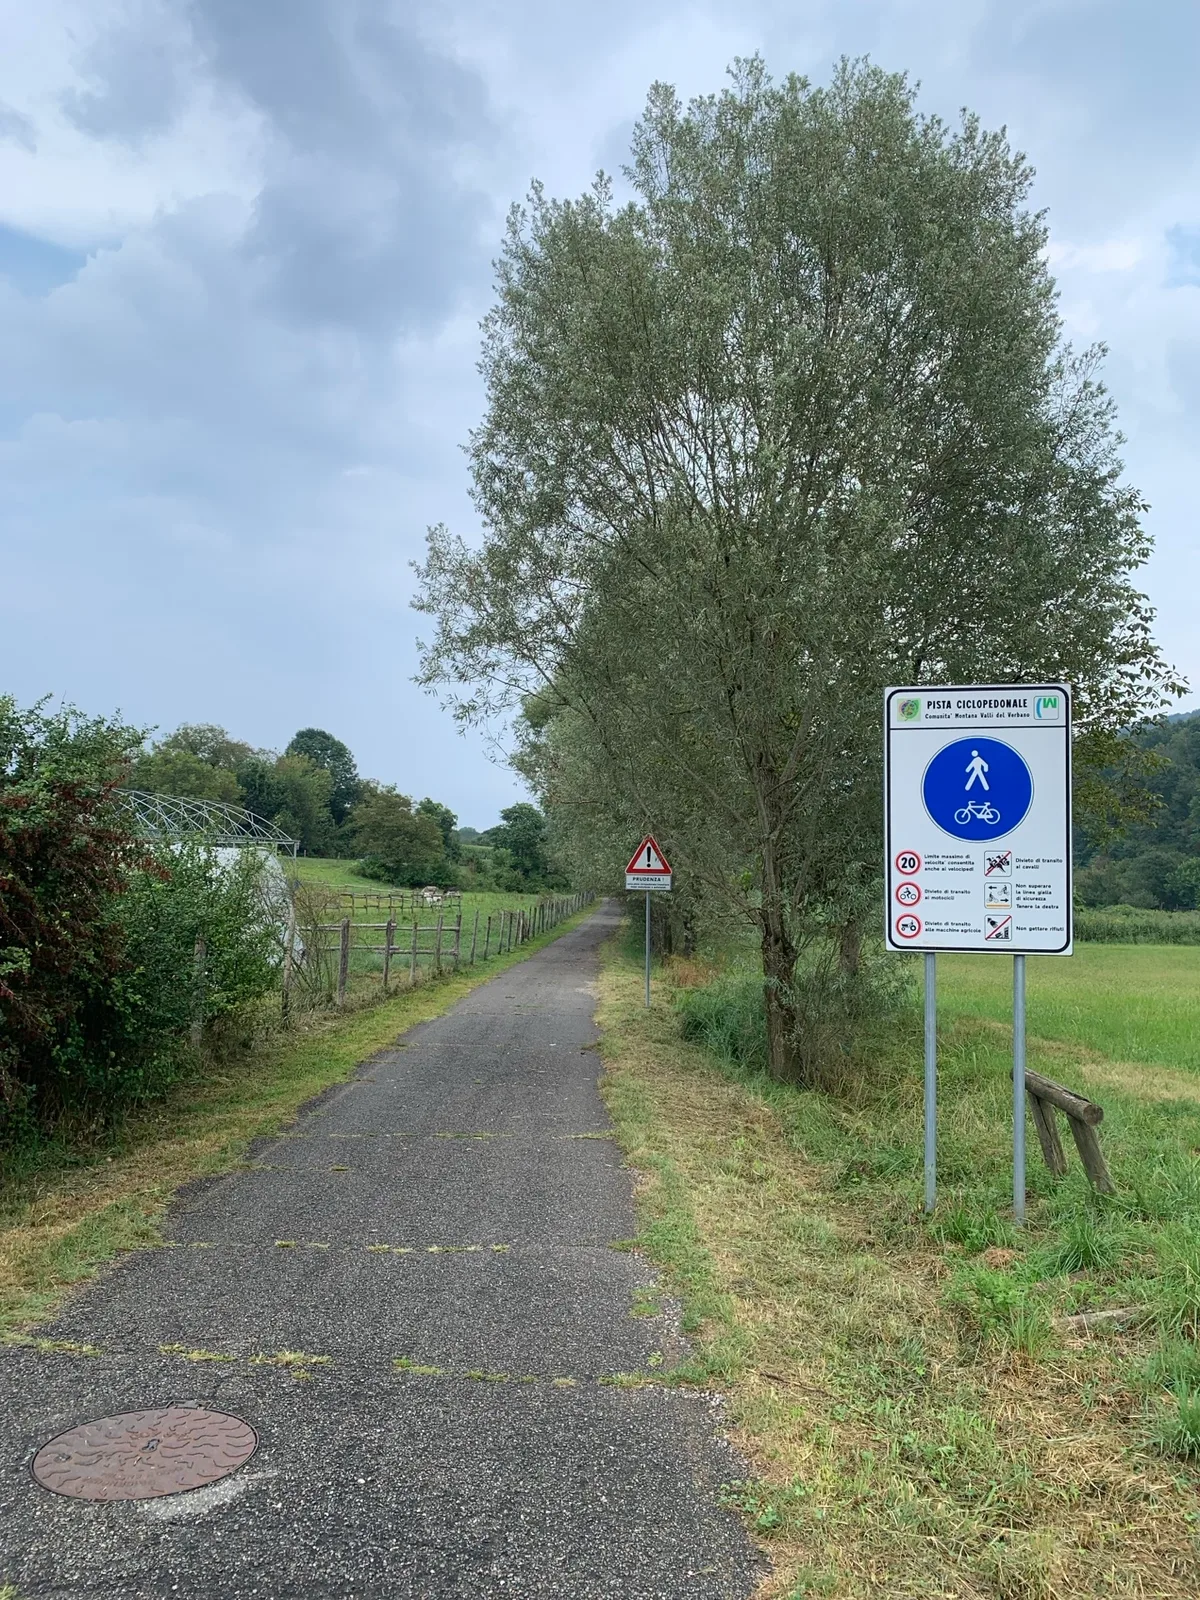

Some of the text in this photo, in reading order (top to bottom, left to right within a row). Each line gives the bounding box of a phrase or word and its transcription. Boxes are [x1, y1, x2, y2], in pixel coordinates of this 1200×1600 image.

[927, 699, 1028, 709] PISTA CICLOPEDONALE
[901, 857, 916, 868] 20
